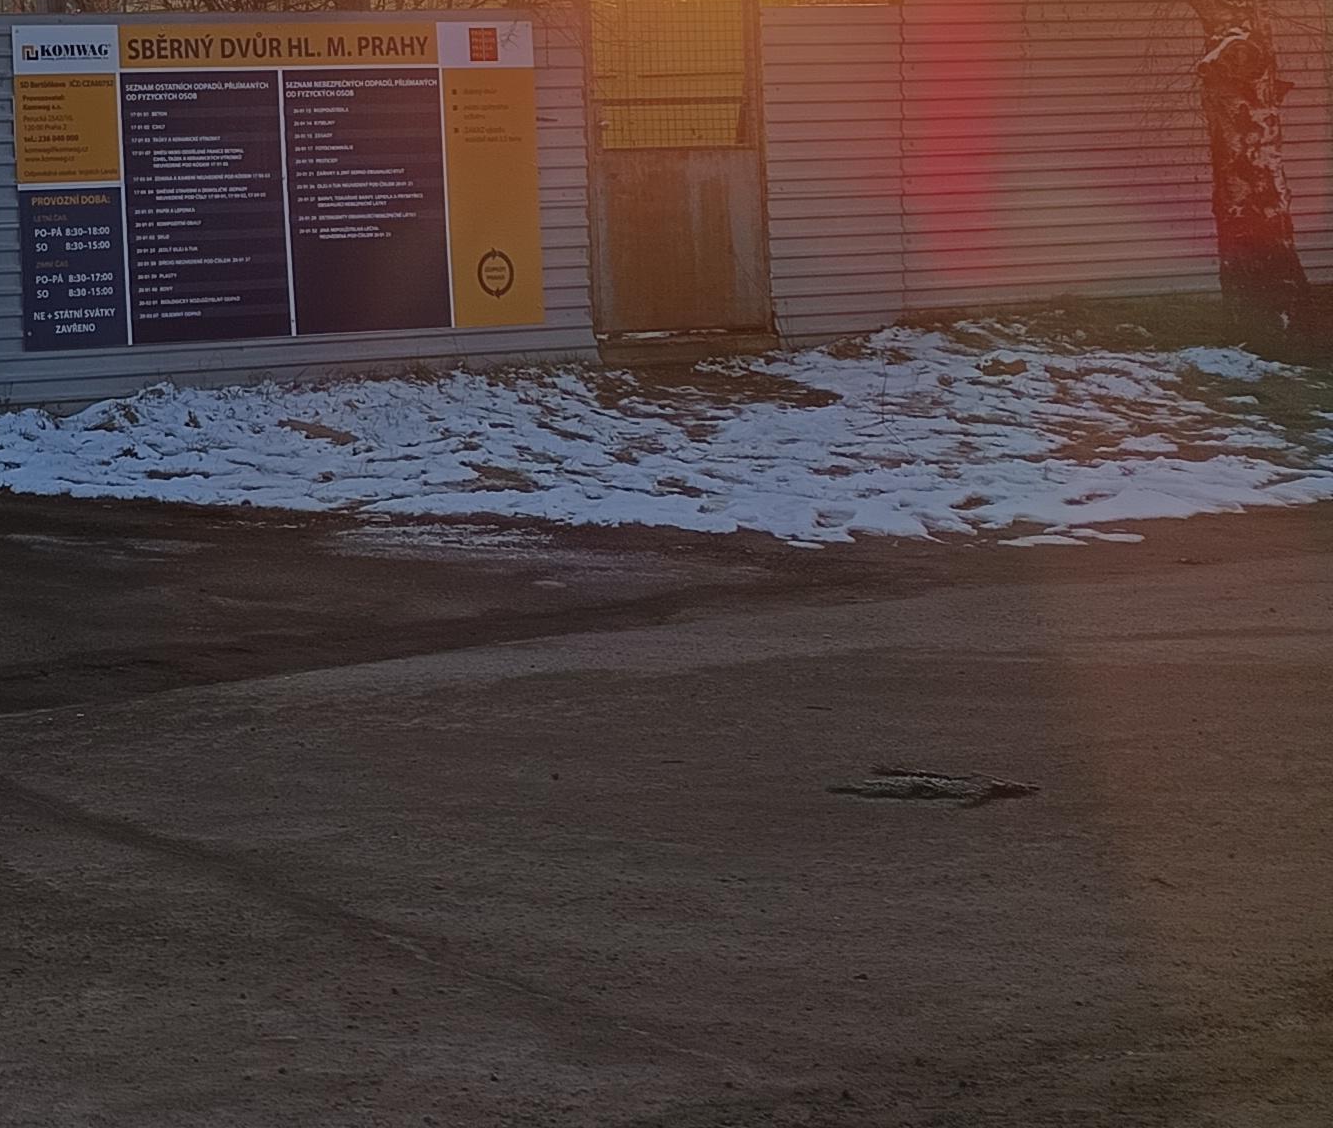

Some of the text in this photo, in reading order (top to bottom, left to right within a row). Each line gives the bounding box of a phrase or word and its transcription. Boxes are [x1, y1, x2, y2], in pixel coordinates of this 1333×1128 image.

[41, 44, 109, 56] KOMWAG
[128, 32, 428, 60] SBĚRNÝ DVŮR HL. M. PRAHY
[126, 84, 153, 92] SEZNAM
[155, 82, 193, 90] OSTATNÍCH
[314, 80, 363, 88] NEBEZPEČNÝCH
[31, 194, 111, 206] PROVOZNÍ DOBA:
[35, 243, 48, 252] SO
[37, 290, 49, 298] SO
[34, 312, 45, 320] NE
[55, 308, 83, 320] STÁTNÍ
[85, 308, 115, 318] SVÁTKY
[55, 322, 95, 334] ZAVŘENO
